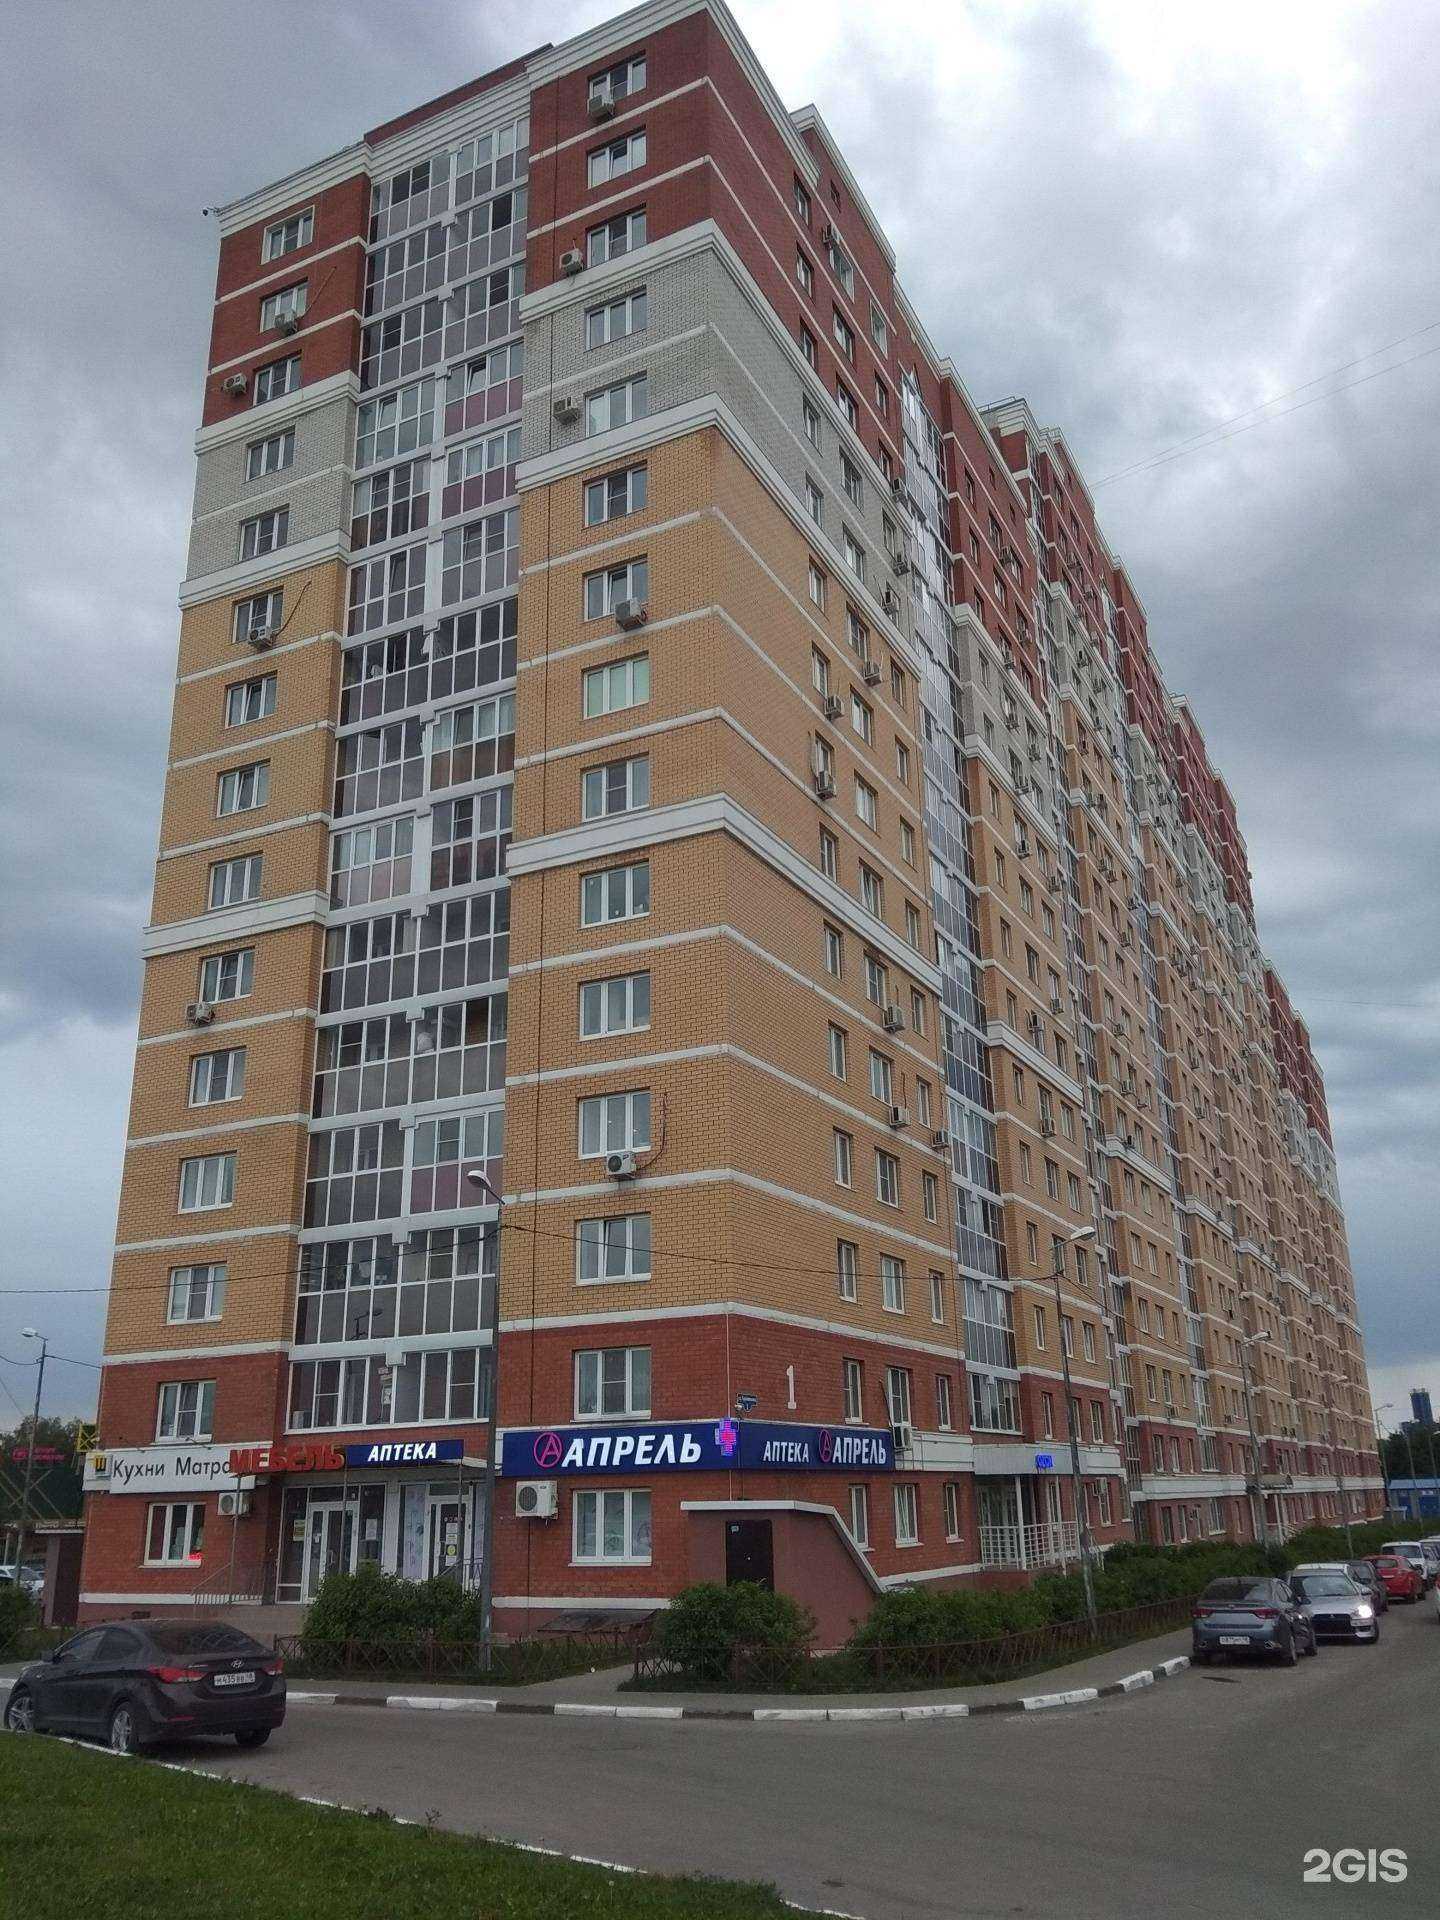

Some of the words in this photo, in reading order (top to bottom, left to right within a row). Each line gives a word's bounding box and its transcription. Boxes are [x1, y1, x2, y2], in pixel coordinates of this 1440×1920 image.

[786, 1364, 797, 1409] 1
[229, 1445, 345, 1473] МЕБЕЛЬ
[367, 1442, 437, 1462] АПТЕКА
[561, 1433, 702, 1468] АПРЕЛЬ
[763, 1441, 810, 1463] АПТЕКА
[832, 1437, 887, 1465] АПРЕЛЬ
[113, 1459, 165, 1485] Кухни
[175, 1456, 231, 1480] Матра
